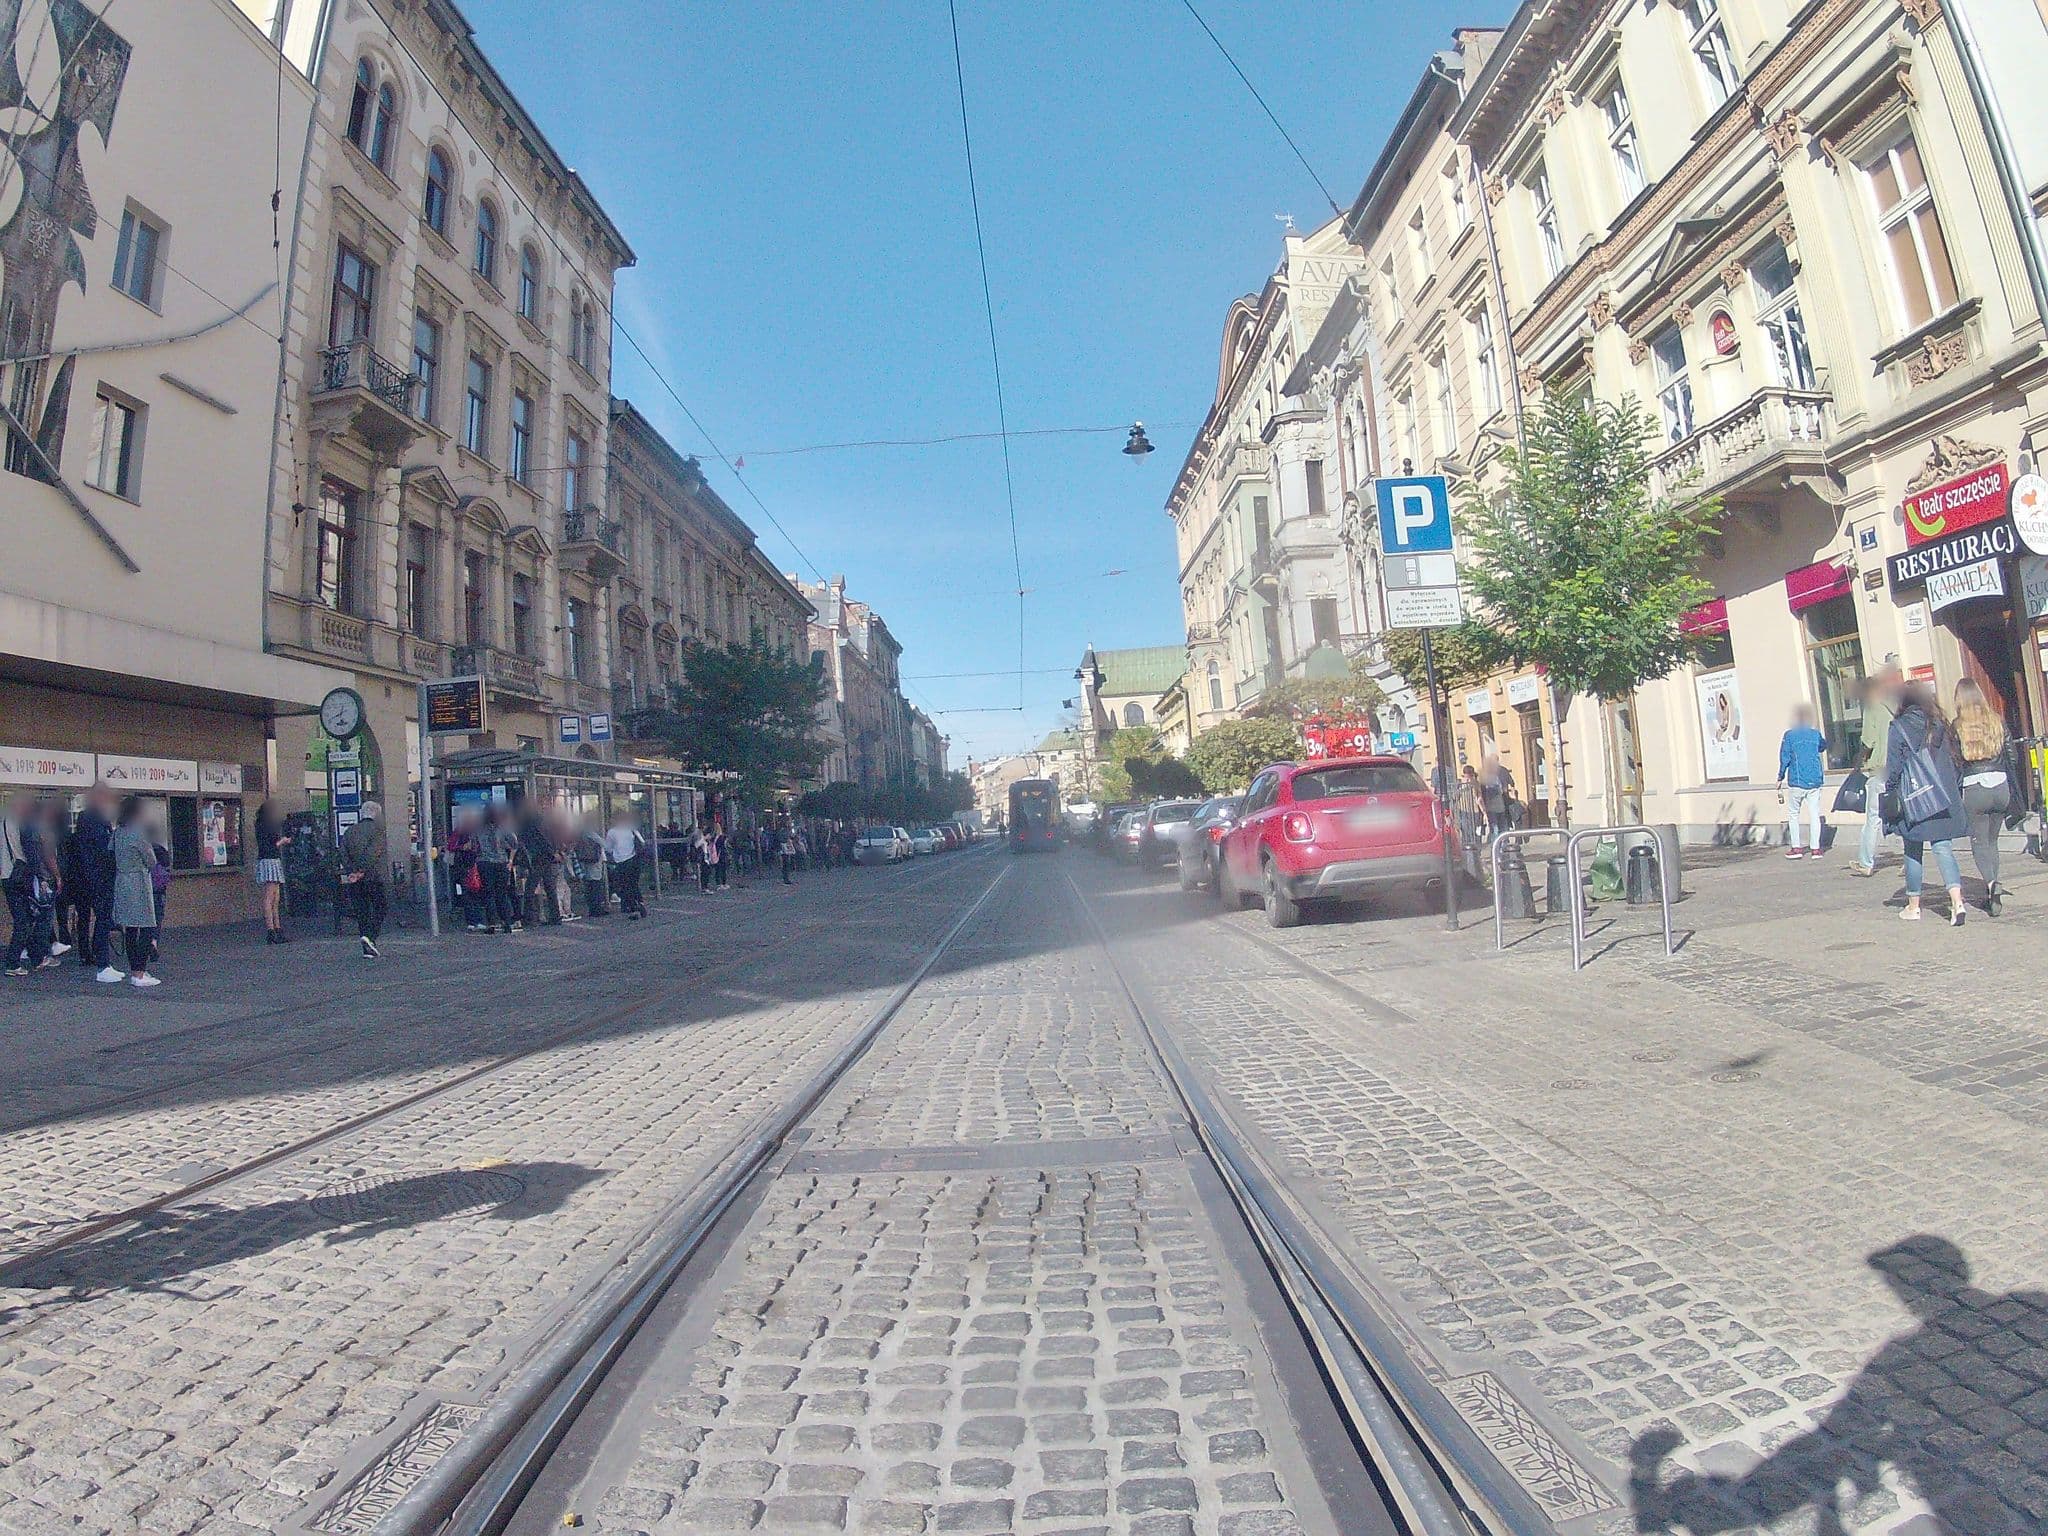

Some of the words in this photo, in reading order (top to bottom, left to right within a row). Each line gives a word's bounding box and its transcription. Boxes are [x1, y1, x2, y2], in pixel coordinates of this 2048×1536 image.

[1390, 485, 1434, 545] P
[1918, 493, 1945, 519] teatr
[1945, 470, 2002, 511] szczęście
[1895, 524, 2015, 582] RESTAURACJ
[37, 760, 57, 775] 2019
[149, 768, 166, 781] 2019
